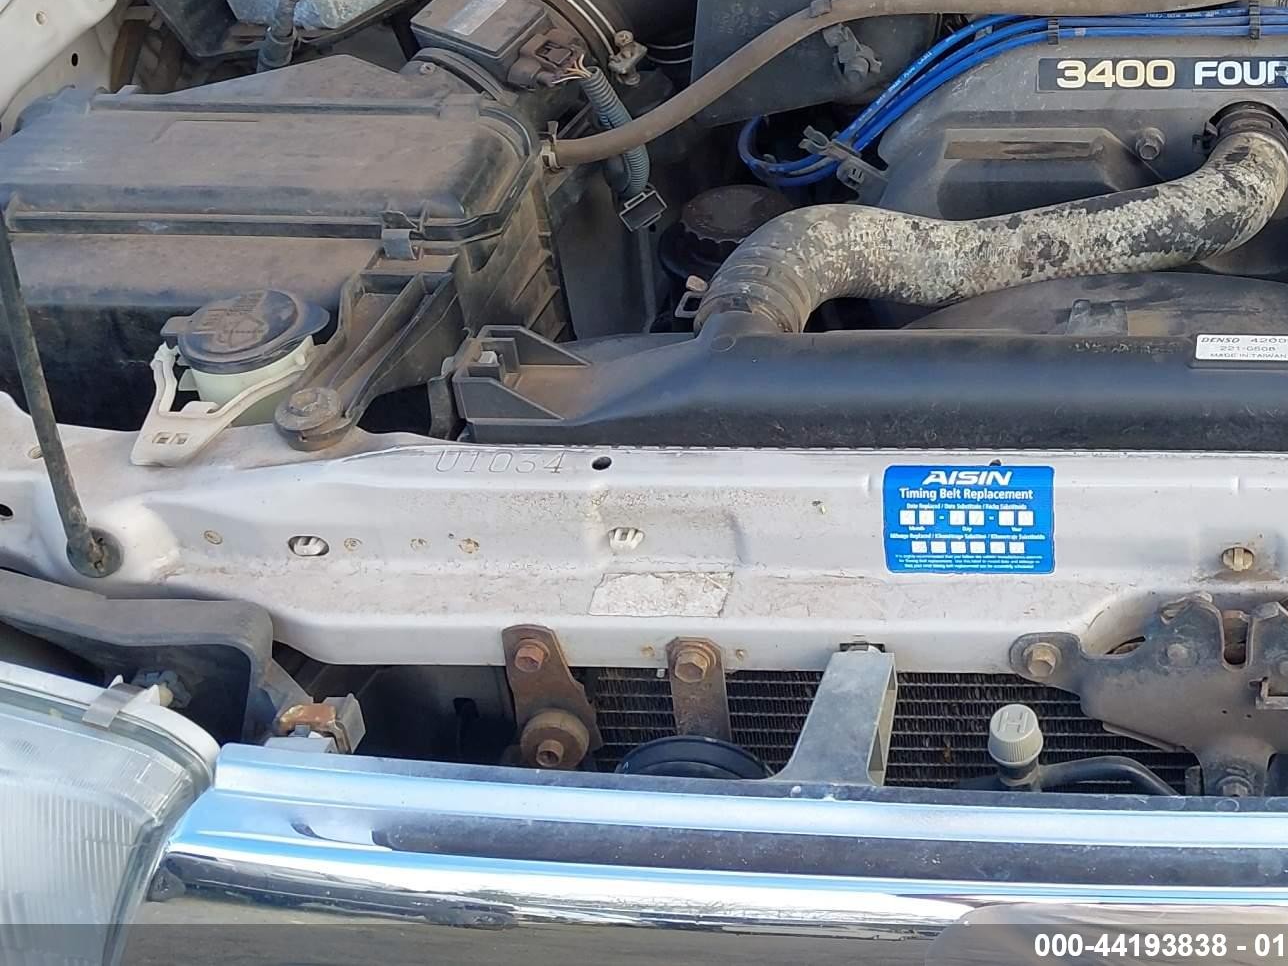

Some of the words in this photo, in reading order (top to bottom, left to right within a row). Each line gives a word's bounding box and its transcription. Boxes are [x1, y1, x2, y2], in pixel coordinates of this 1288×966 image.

[1056, 58, 1176, 89] 3400
[921, 470, 1013, 486] AISIN
[899, 487, 937, 502] Timing
[939, 487, 961, 499] Belt
[963, 488, 1034, 502] Replacement
[961, 525, 973, 533] Day
